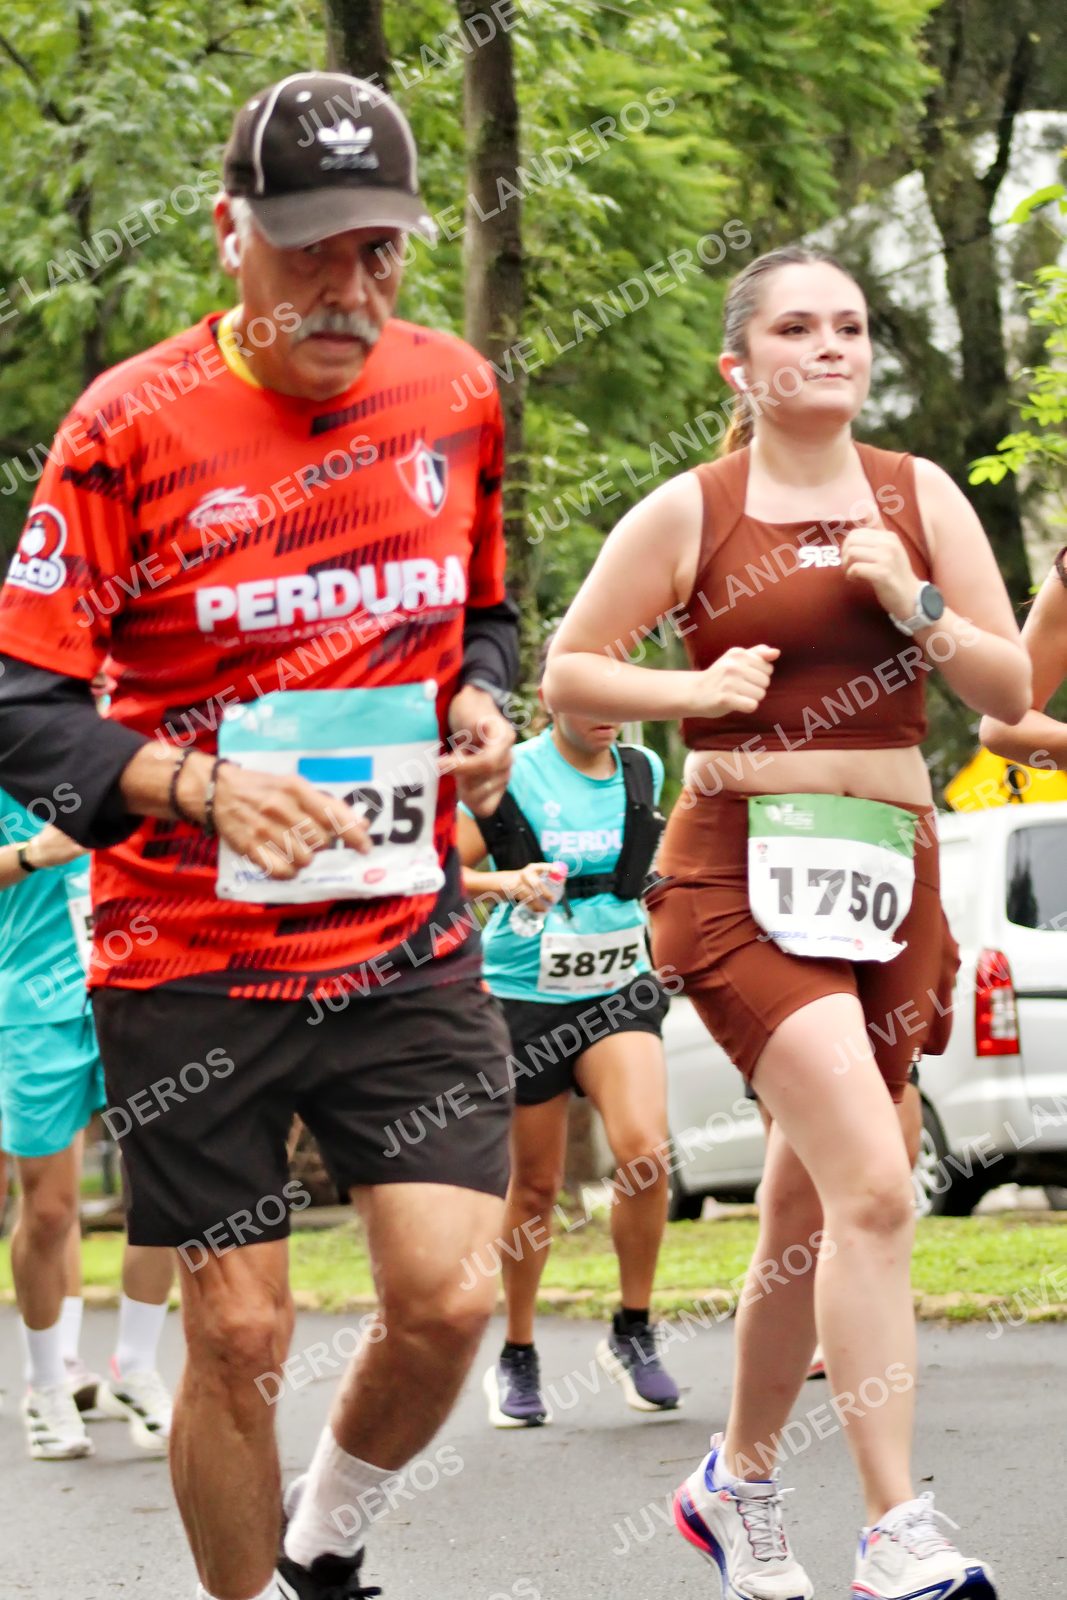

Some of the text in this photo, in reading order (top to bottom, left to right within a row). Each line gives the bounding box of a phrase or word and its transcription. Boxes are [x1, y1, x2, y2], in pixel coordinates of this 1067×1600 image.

[195, 555, 467, 633] PERDURA
[769, 867, 898, 931] 1750
[548, 943, 638, 977] 3875
